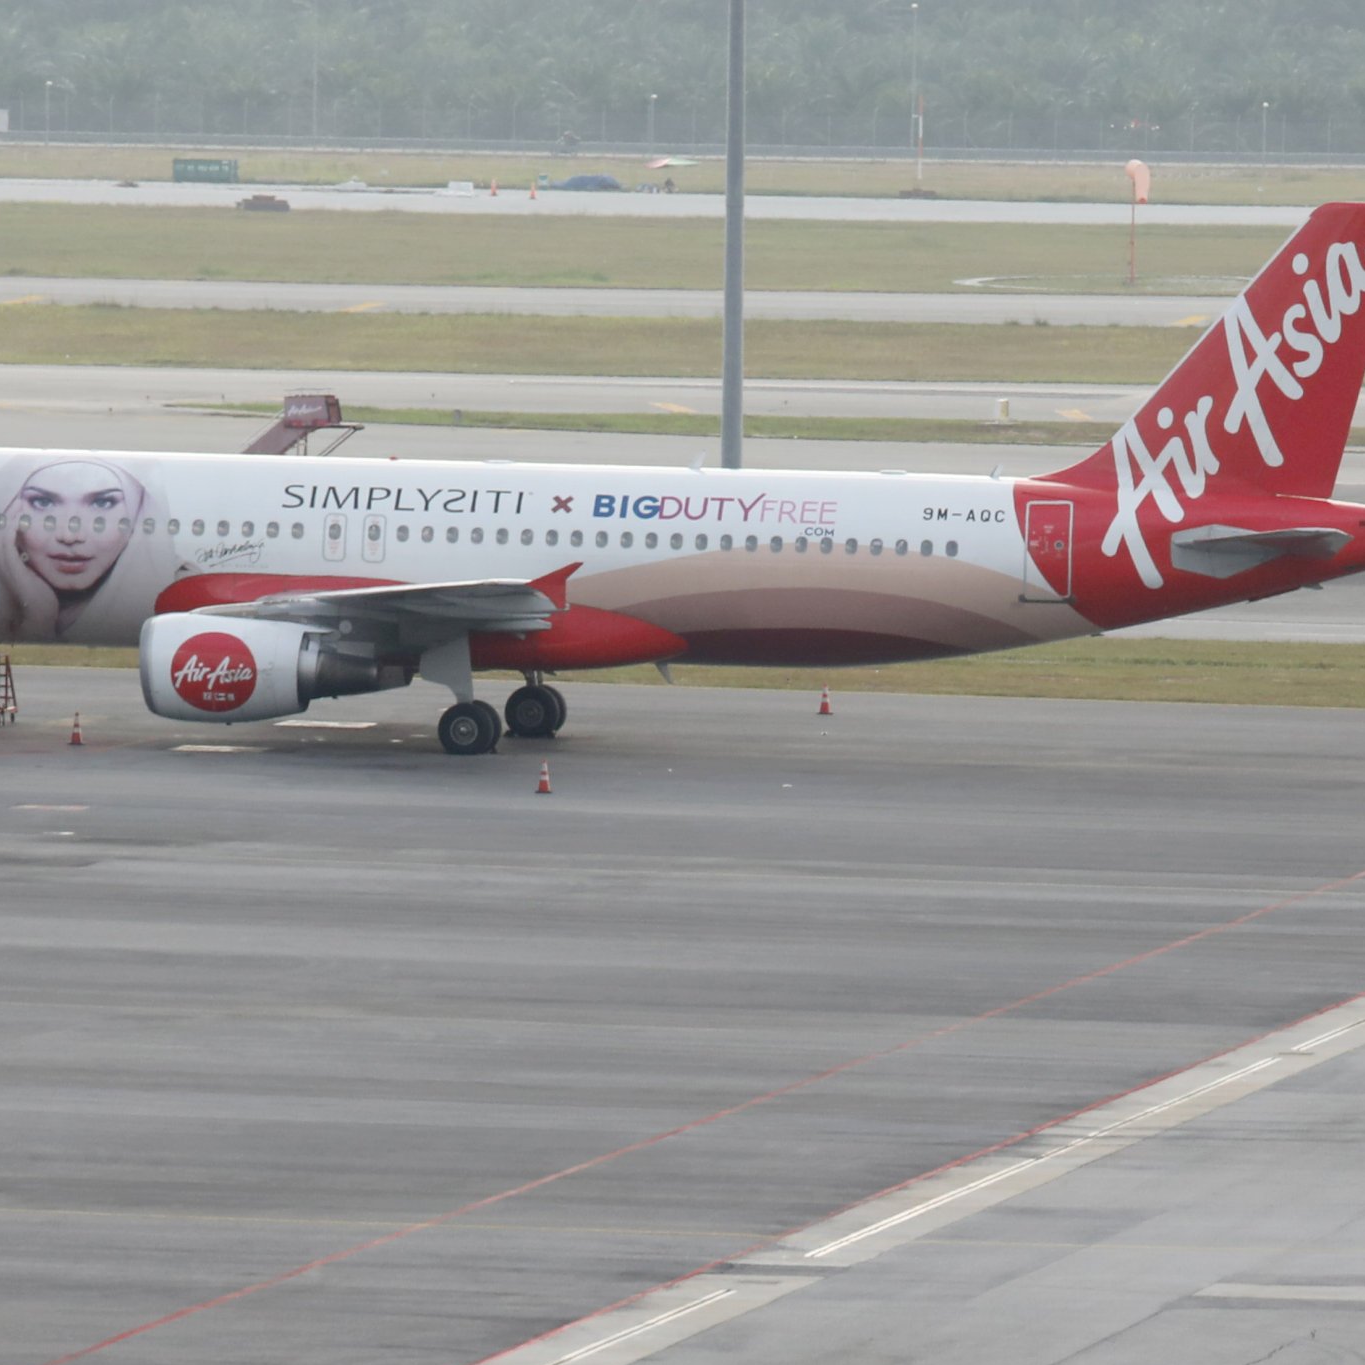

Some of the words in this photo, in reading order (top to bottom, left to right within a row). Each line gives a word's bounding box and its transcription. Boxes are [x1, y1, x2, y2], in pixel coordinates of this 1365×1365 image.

[282, 484, 525, 515] SIMPLYSITI
[592, 493, 838, 525] BIGDUTYFREE
[923, 507, 1006, 523] 9M-AQC
